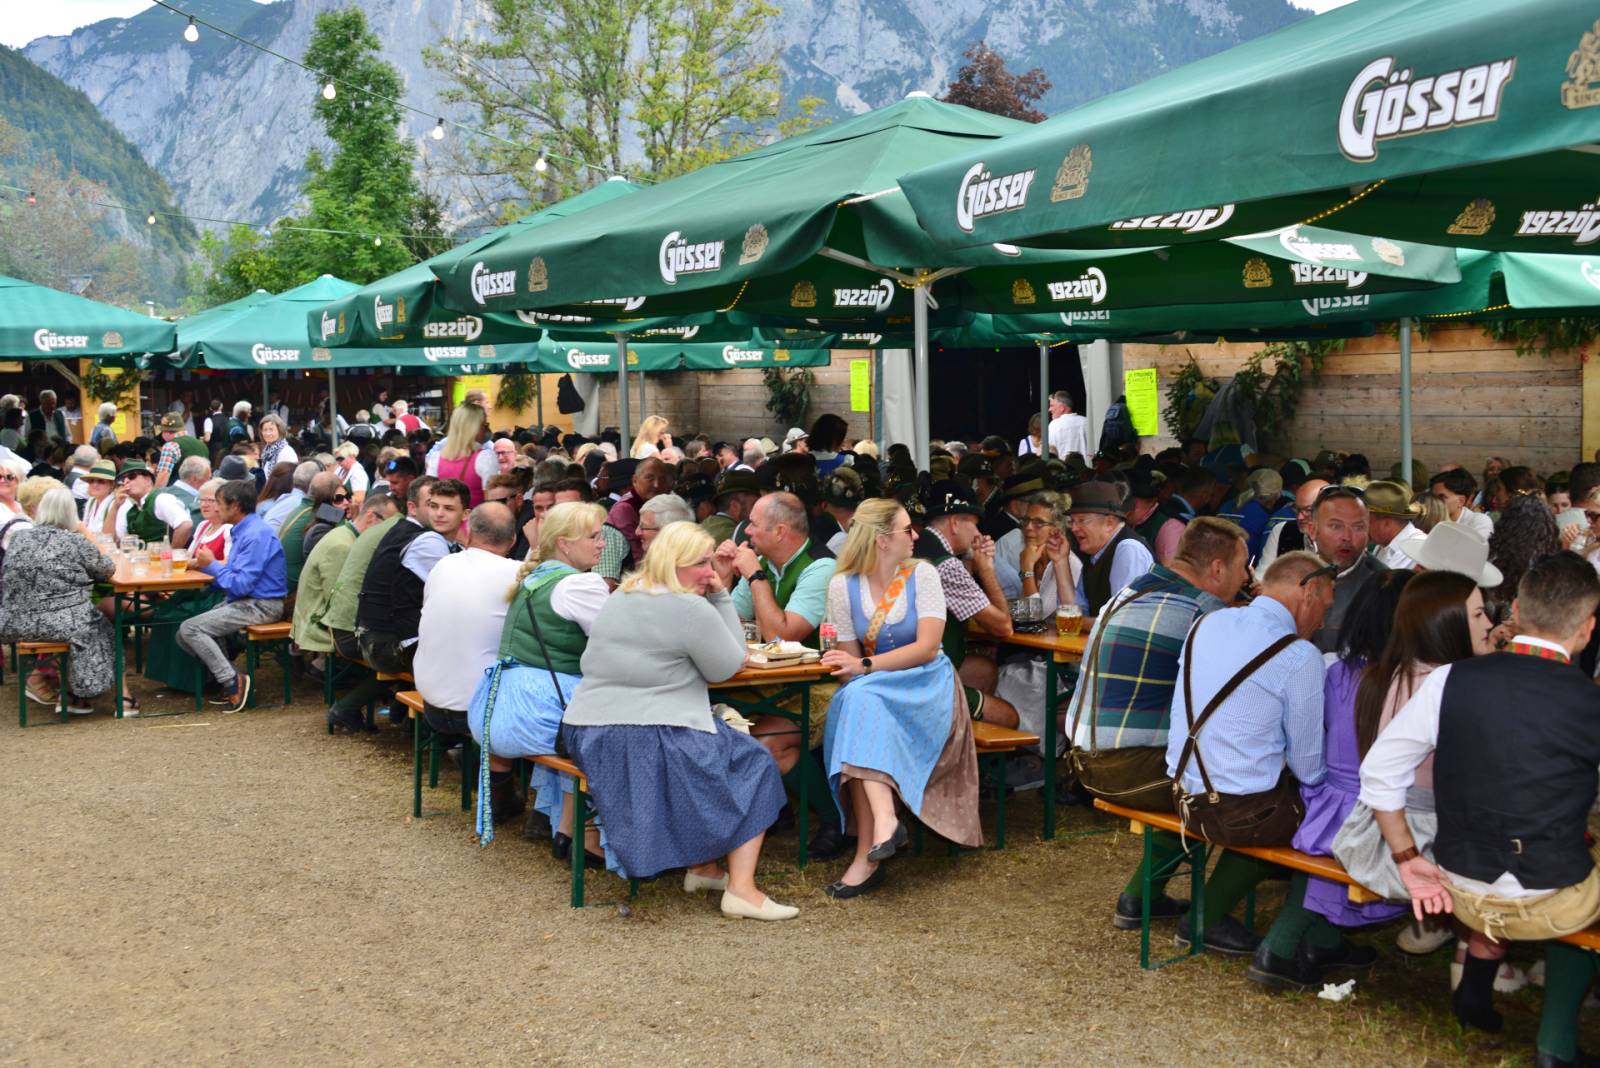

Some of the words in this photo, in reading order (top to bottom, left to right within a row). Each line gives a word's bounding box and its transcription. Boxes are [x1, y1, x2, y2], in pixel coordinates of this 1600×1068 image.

[1338, 56, 1516, 161] Gösser
[957, 161, 1035, 233] Gösser
[660, 230, 724, 285] Gösser
[470, 260, 517, 306] Gösser
[33, 328, 90, 354] Gösser
[252, 343, 301, 365] Gösser
[567, 348, 611, 369] Gösser
[723, 345, 764, 365] Gösser
